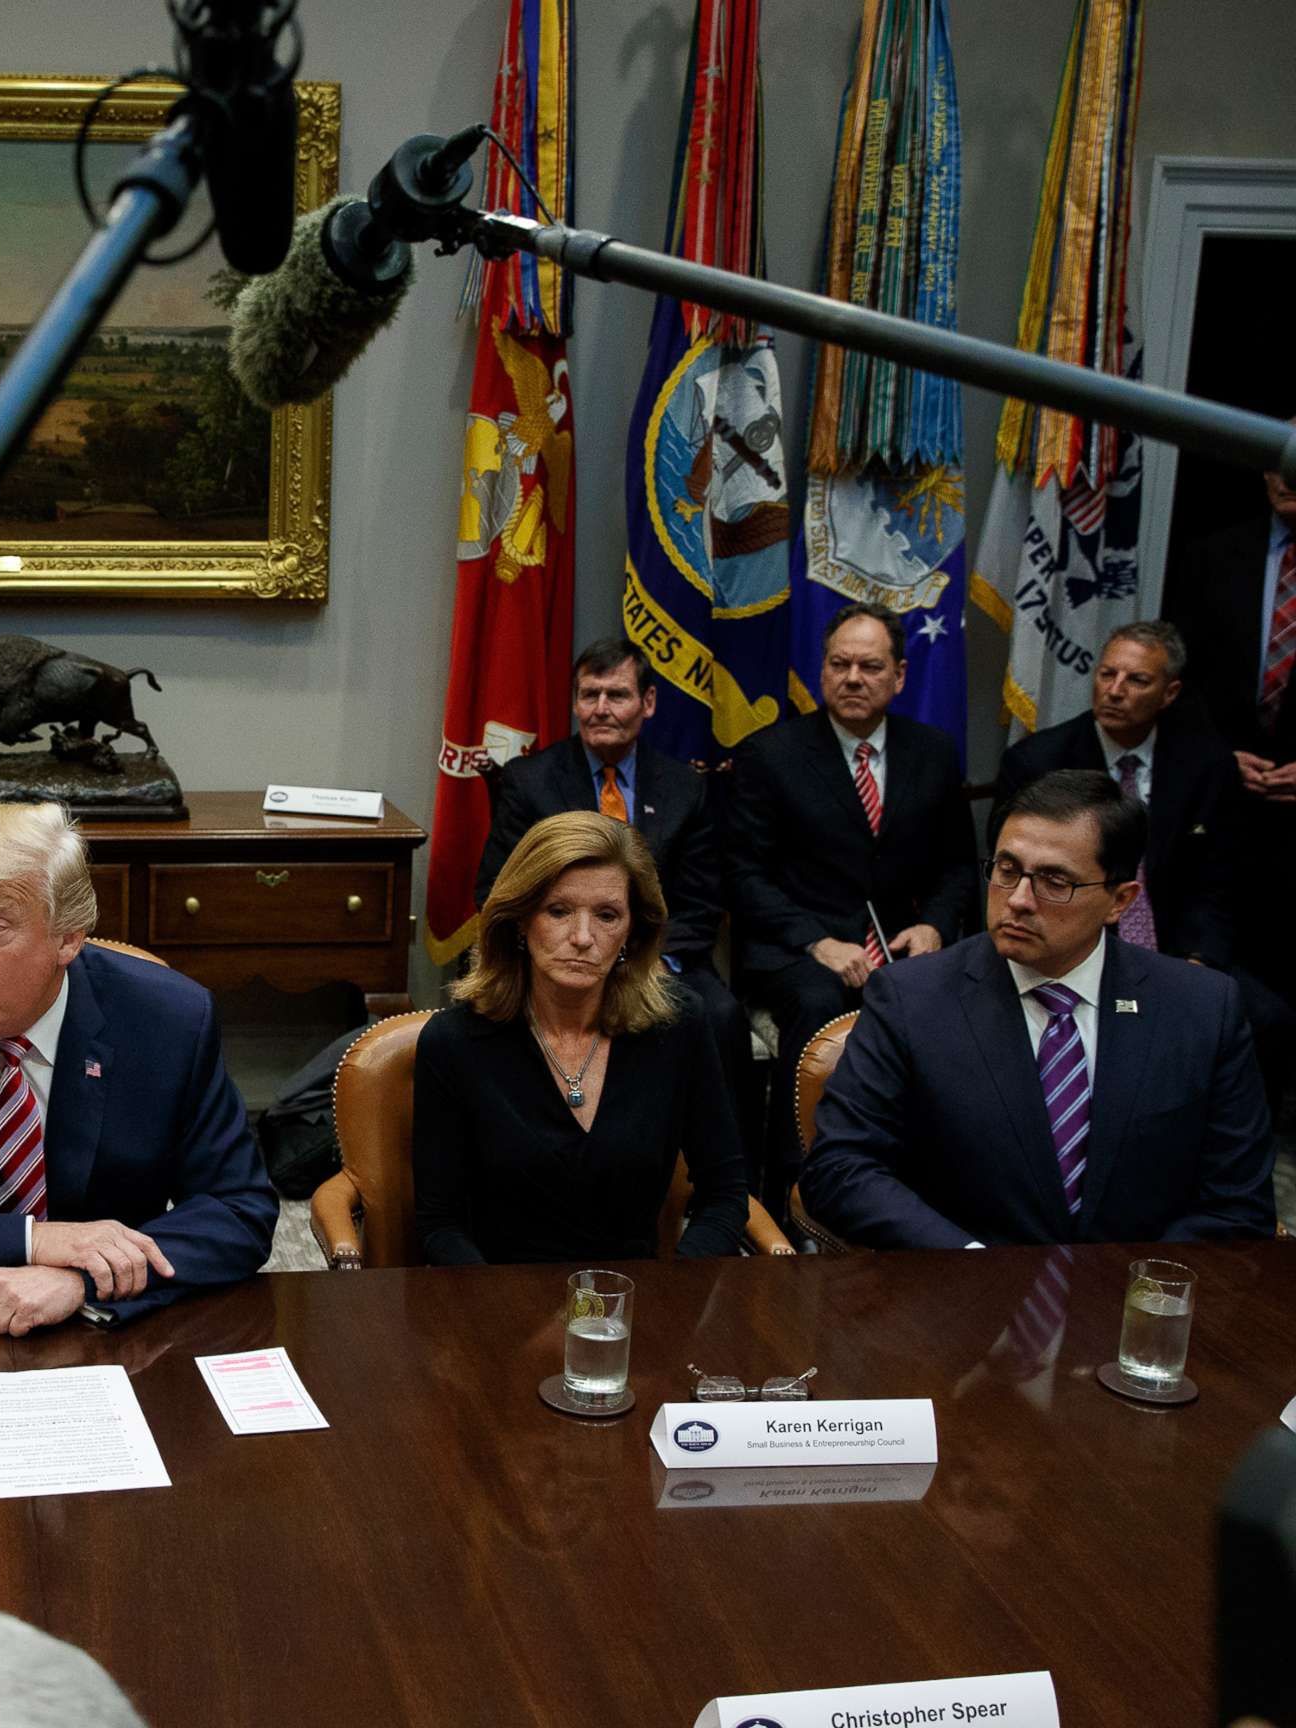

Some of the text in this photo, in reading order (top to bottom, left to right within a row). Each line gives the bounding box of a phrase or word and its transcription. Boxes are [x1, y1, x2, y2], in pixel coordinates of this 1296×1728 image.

[766, 1418, 883, 1435] Karen Kerrigan
[747, 1438, 905, 1449] Small Business & Entrepreneurship Council
[831, 1700, 1008, 1728] Christopher Spear
